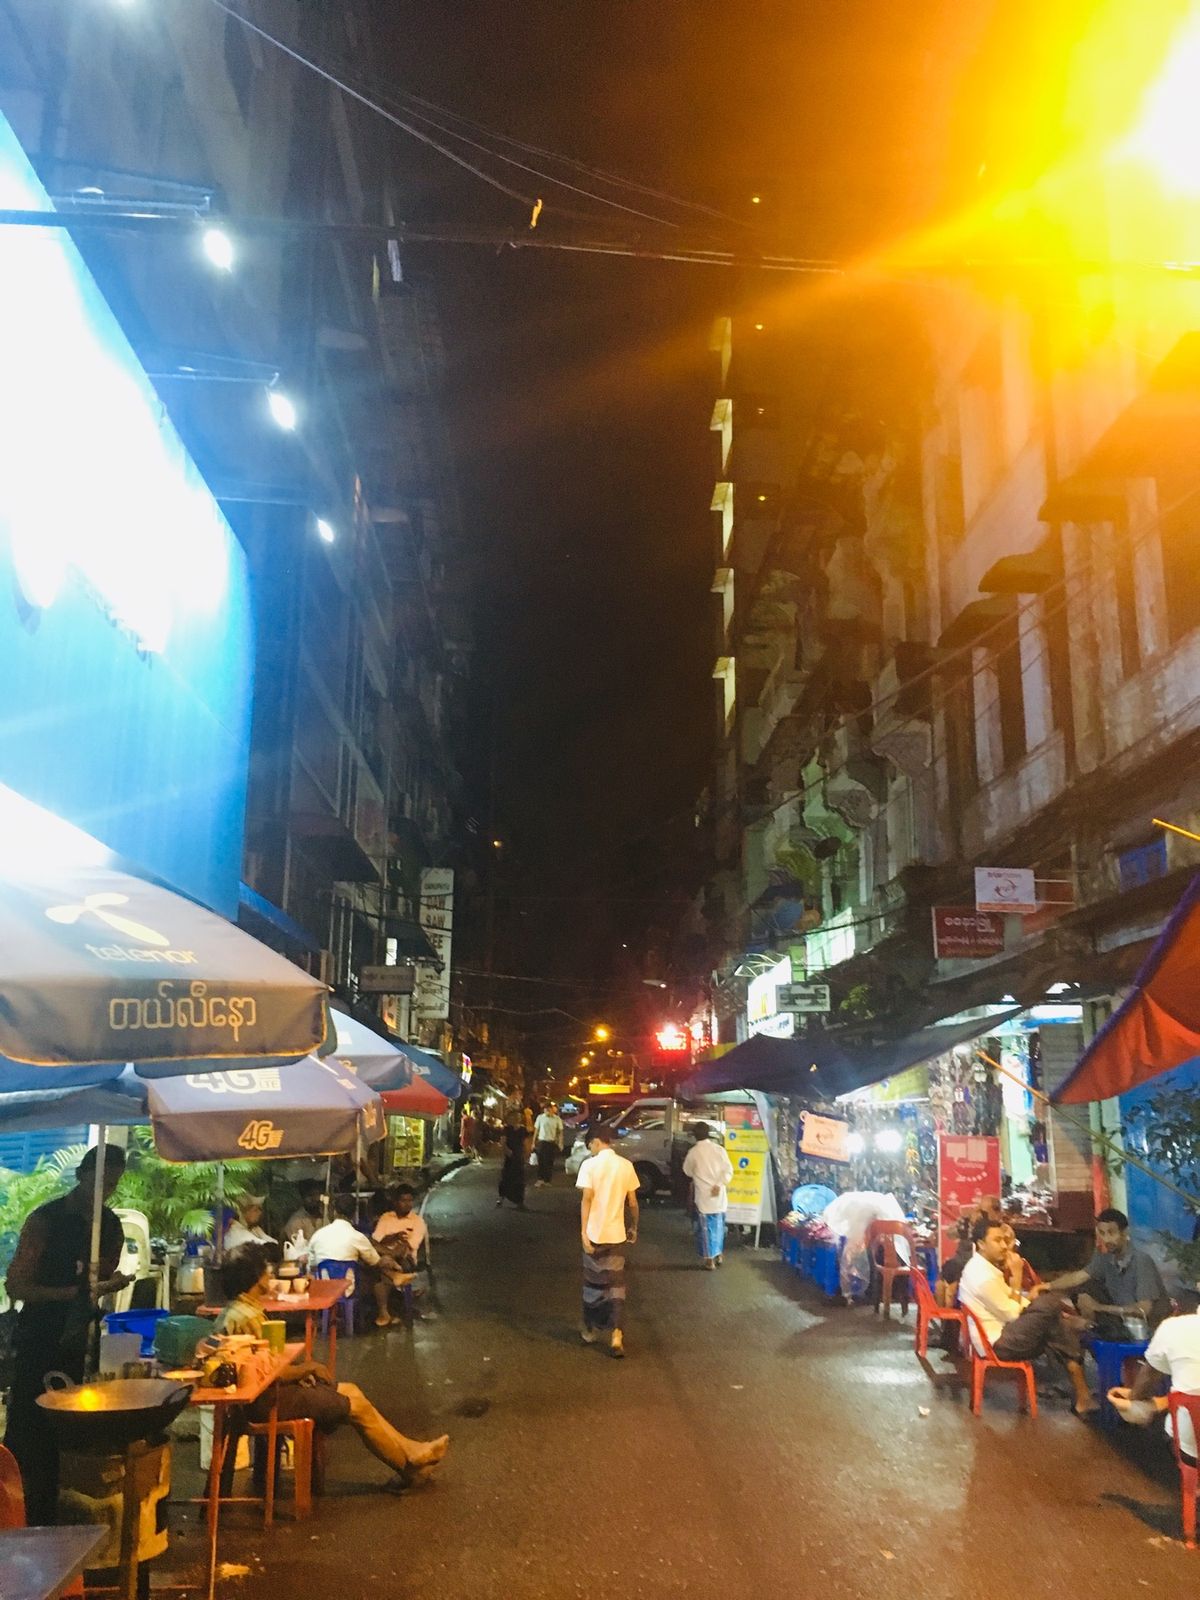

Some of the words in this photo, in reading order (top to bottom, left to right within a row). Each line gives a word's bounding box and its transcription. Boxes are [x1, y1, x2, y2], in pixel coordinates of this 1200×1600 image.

[85, 943, 198, 964] telenor
[109, 981, 257, 1042] တယ်လီနော
[239, 1121, 273, 1149] 4G
